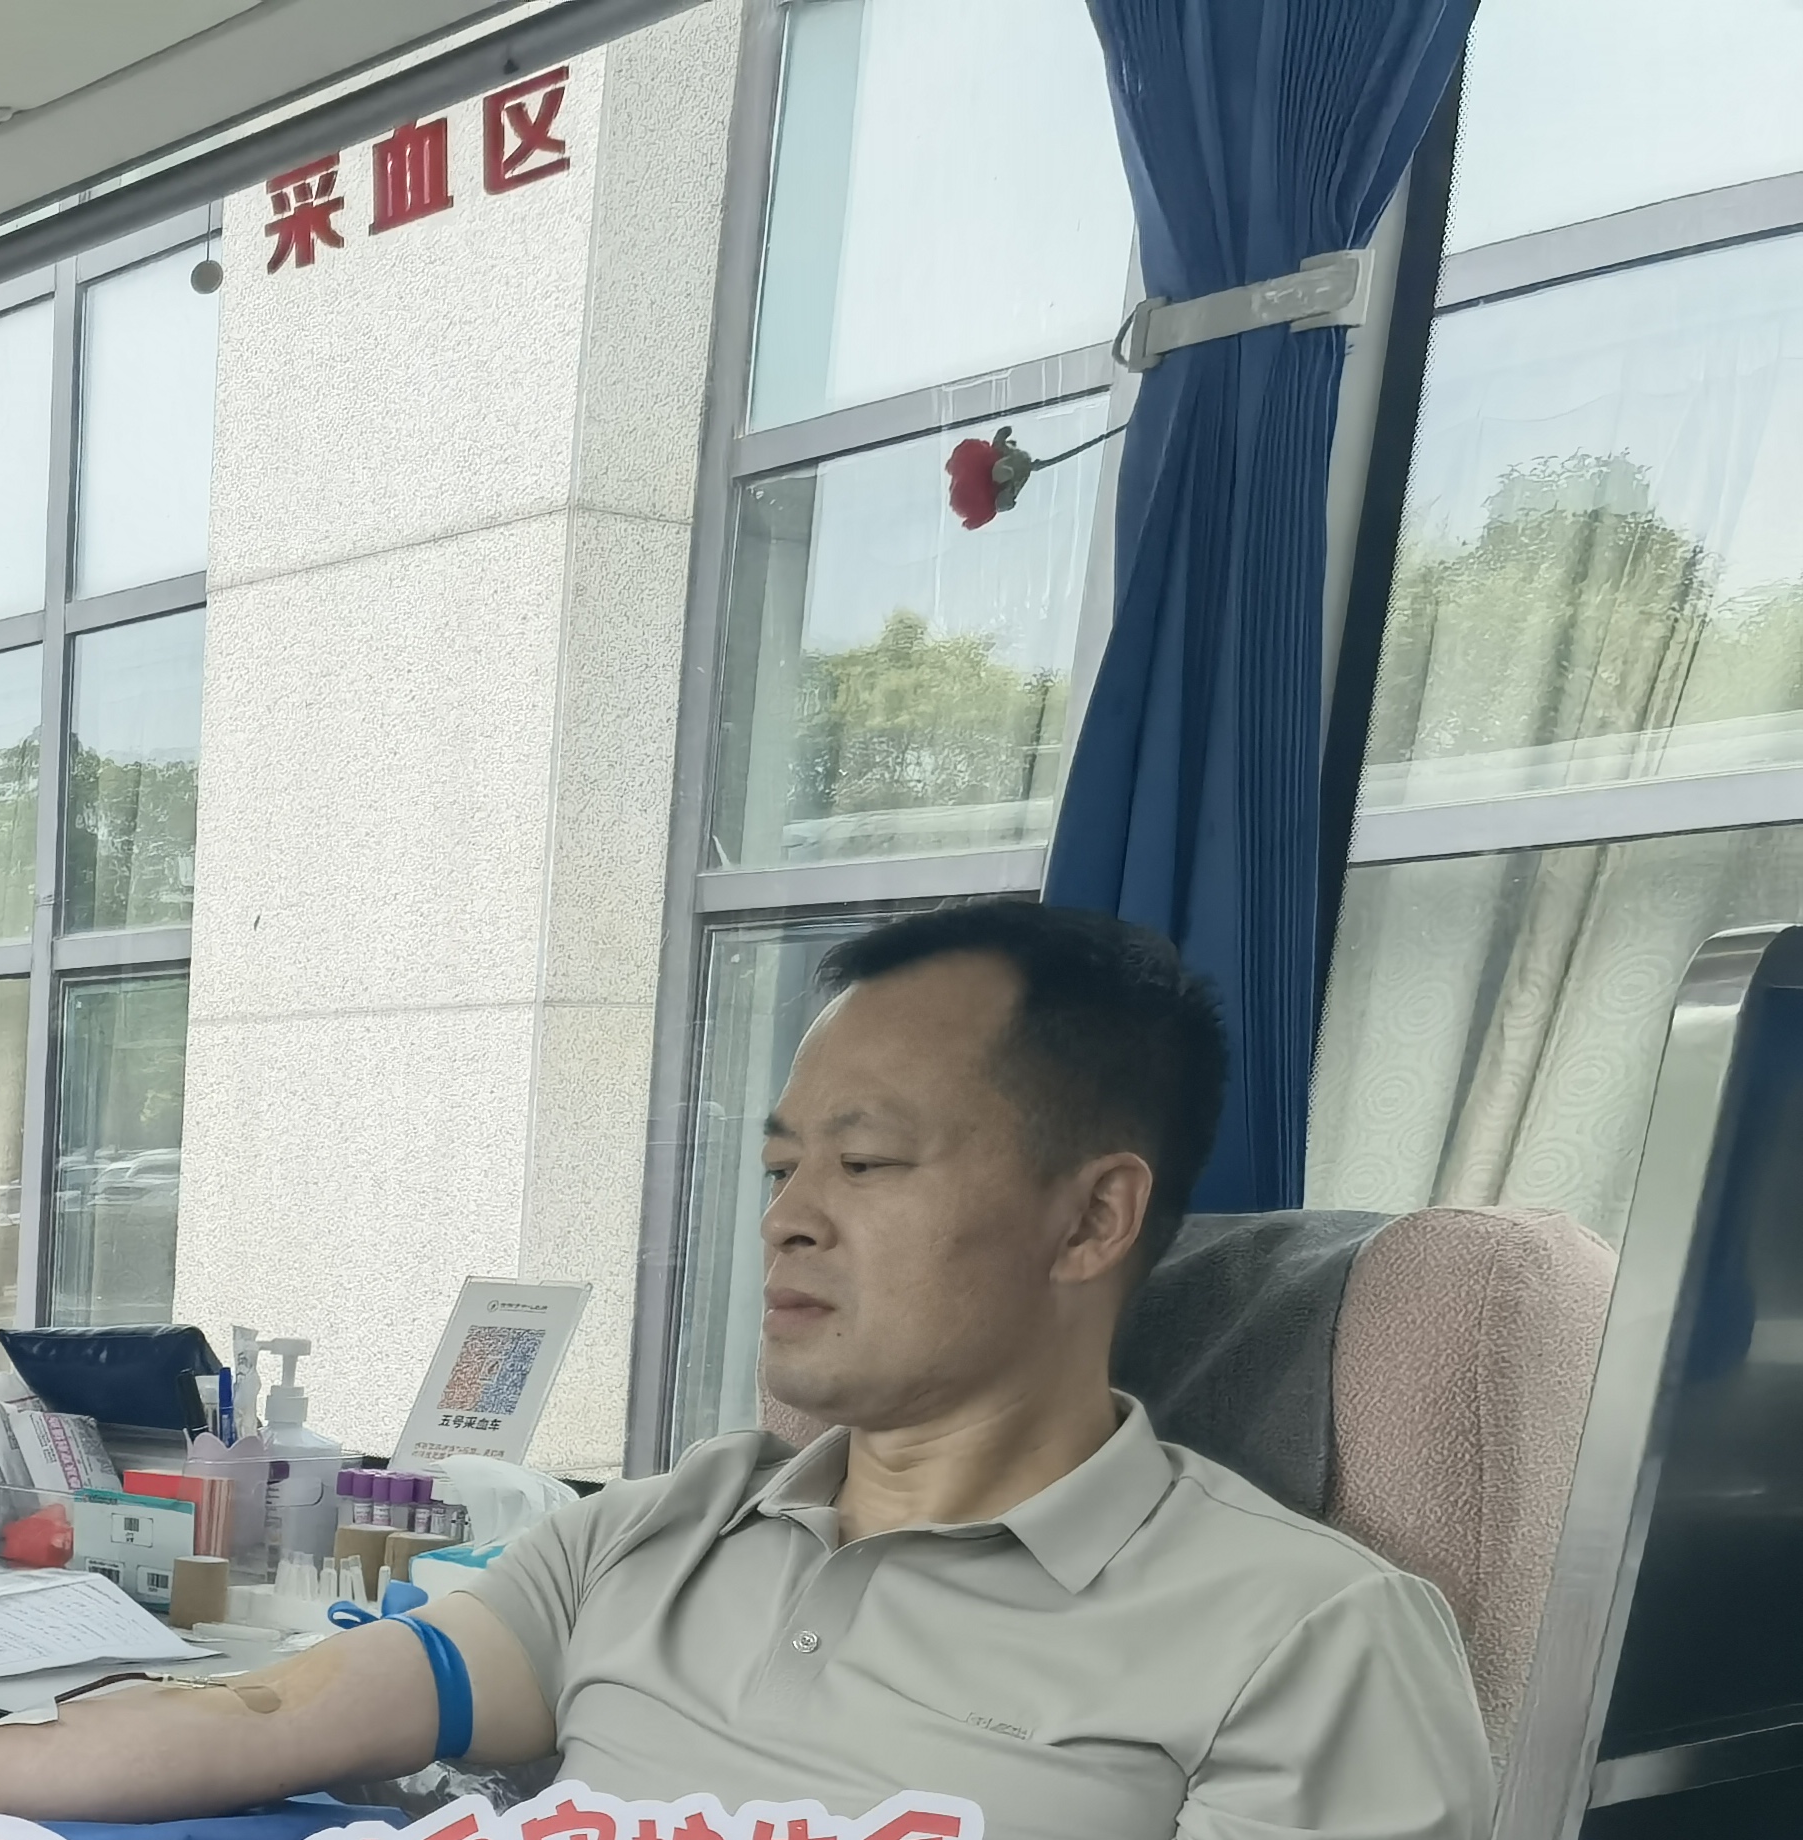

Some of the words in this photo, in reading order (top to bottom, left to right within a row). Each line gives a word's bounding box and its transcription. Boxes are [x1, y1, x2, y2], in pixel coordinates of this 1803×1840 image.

[264, 66, 571, 275] 采血区
[438, 1414, 503, 1432] 五号采血车
